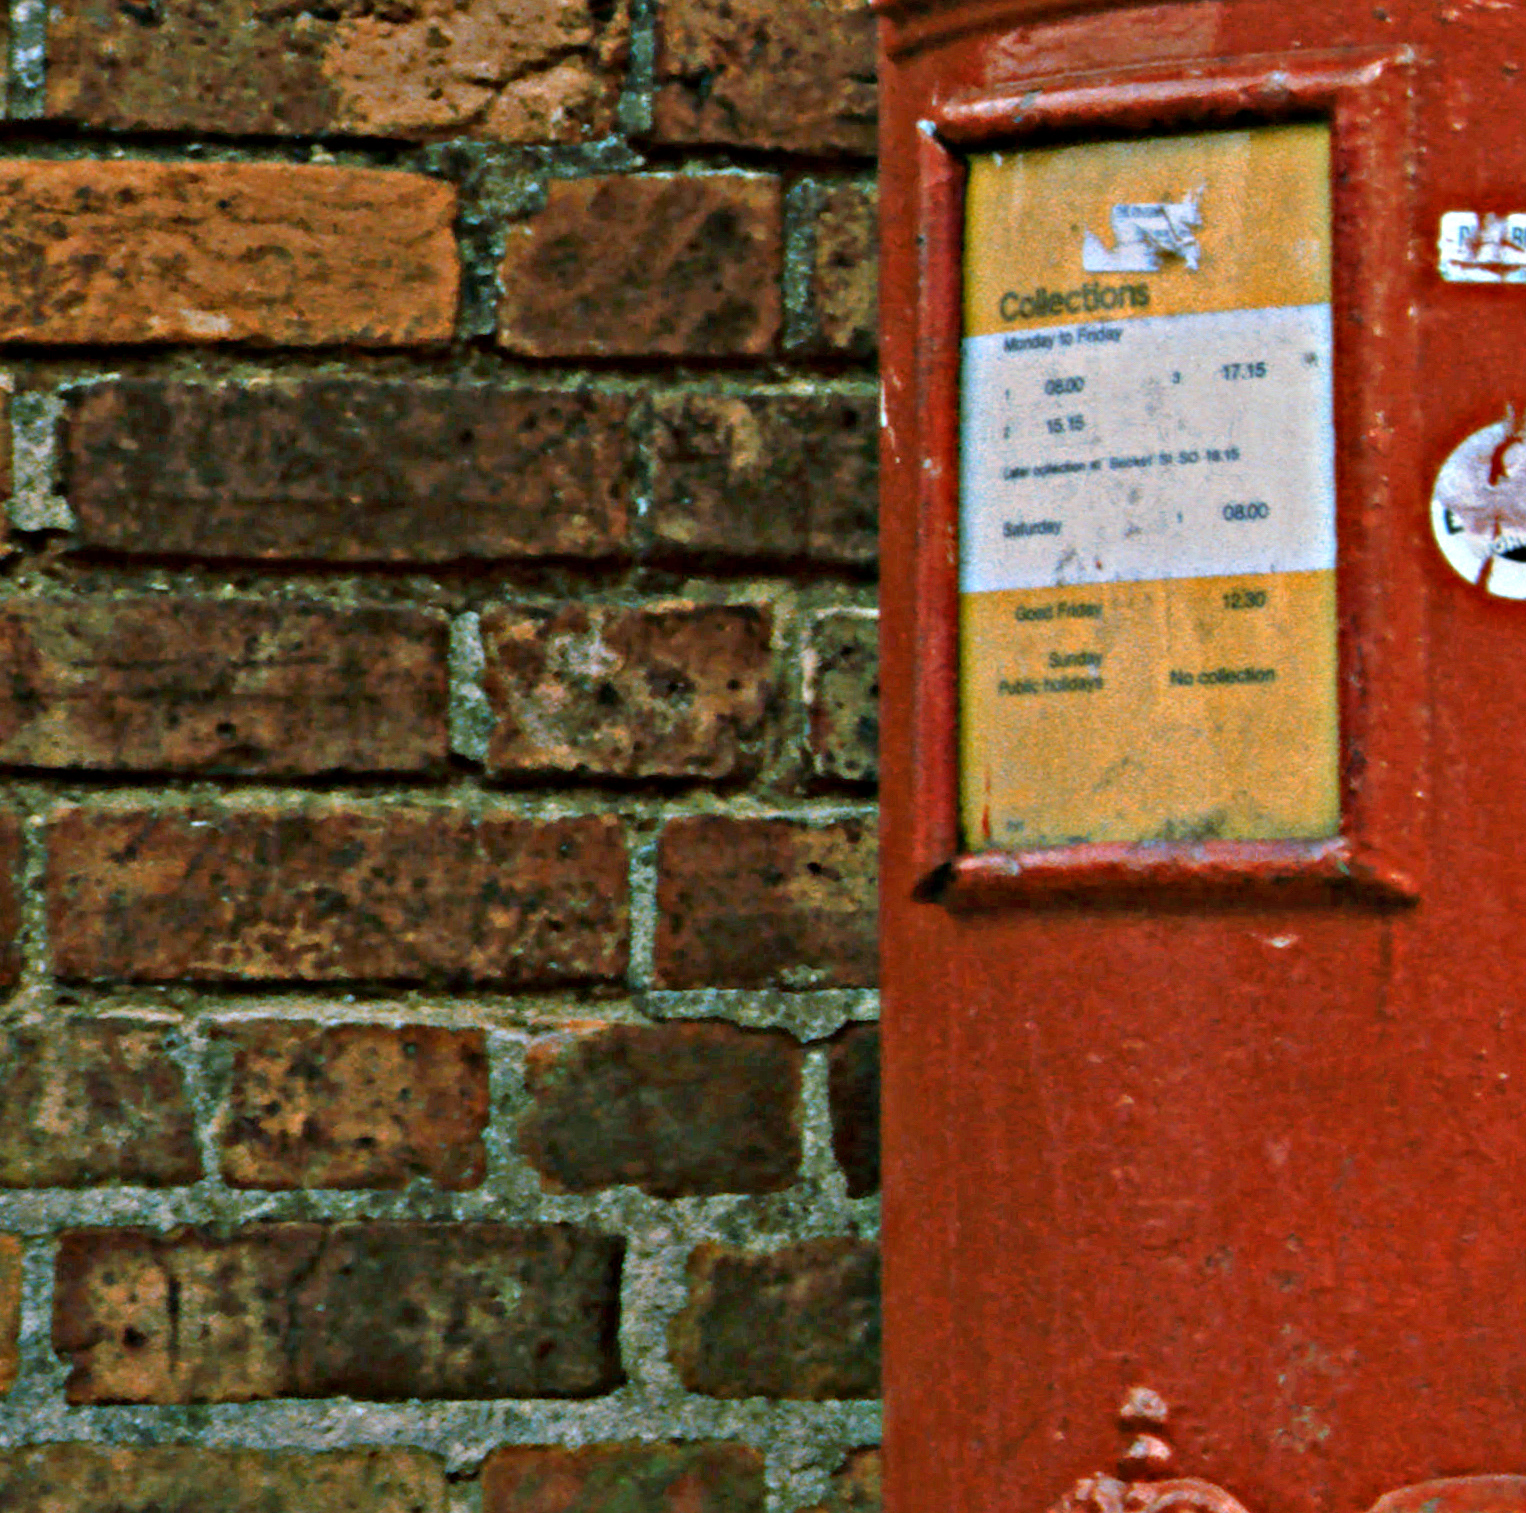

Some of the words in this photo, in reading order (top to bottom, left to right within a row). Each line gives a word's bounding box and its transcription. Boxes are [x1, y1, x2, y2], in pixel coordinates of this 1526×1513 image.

[999, 282, 1150, 322] Collections
[1003, 331, 1055, 353] Monday
[1059, 329, 1074, 347] to
[1078, 325, 1124, 346] Friday
[1044, 375, 1085, 396] 08.00
[1171, 370, 1181, 384] 3
[1221, 361, 1267, 381] 17.15
[1046, 413, 1086, 435] 15.15
[1003, 519, 1063, 540] Saturday
[1222, 501, 1270, 521] 08.00
[1014, 604, 1054, 622] Good
[1057, 600, 1103, 620] Friday
[1048, 650, 1103, 669] Sunday
[999, 679, 1039, 697] Public
[1043, 675, 1104, 694] holidays
[1169, 668, 1194, 687] No
[1196, 666, 1277, 686] collection
